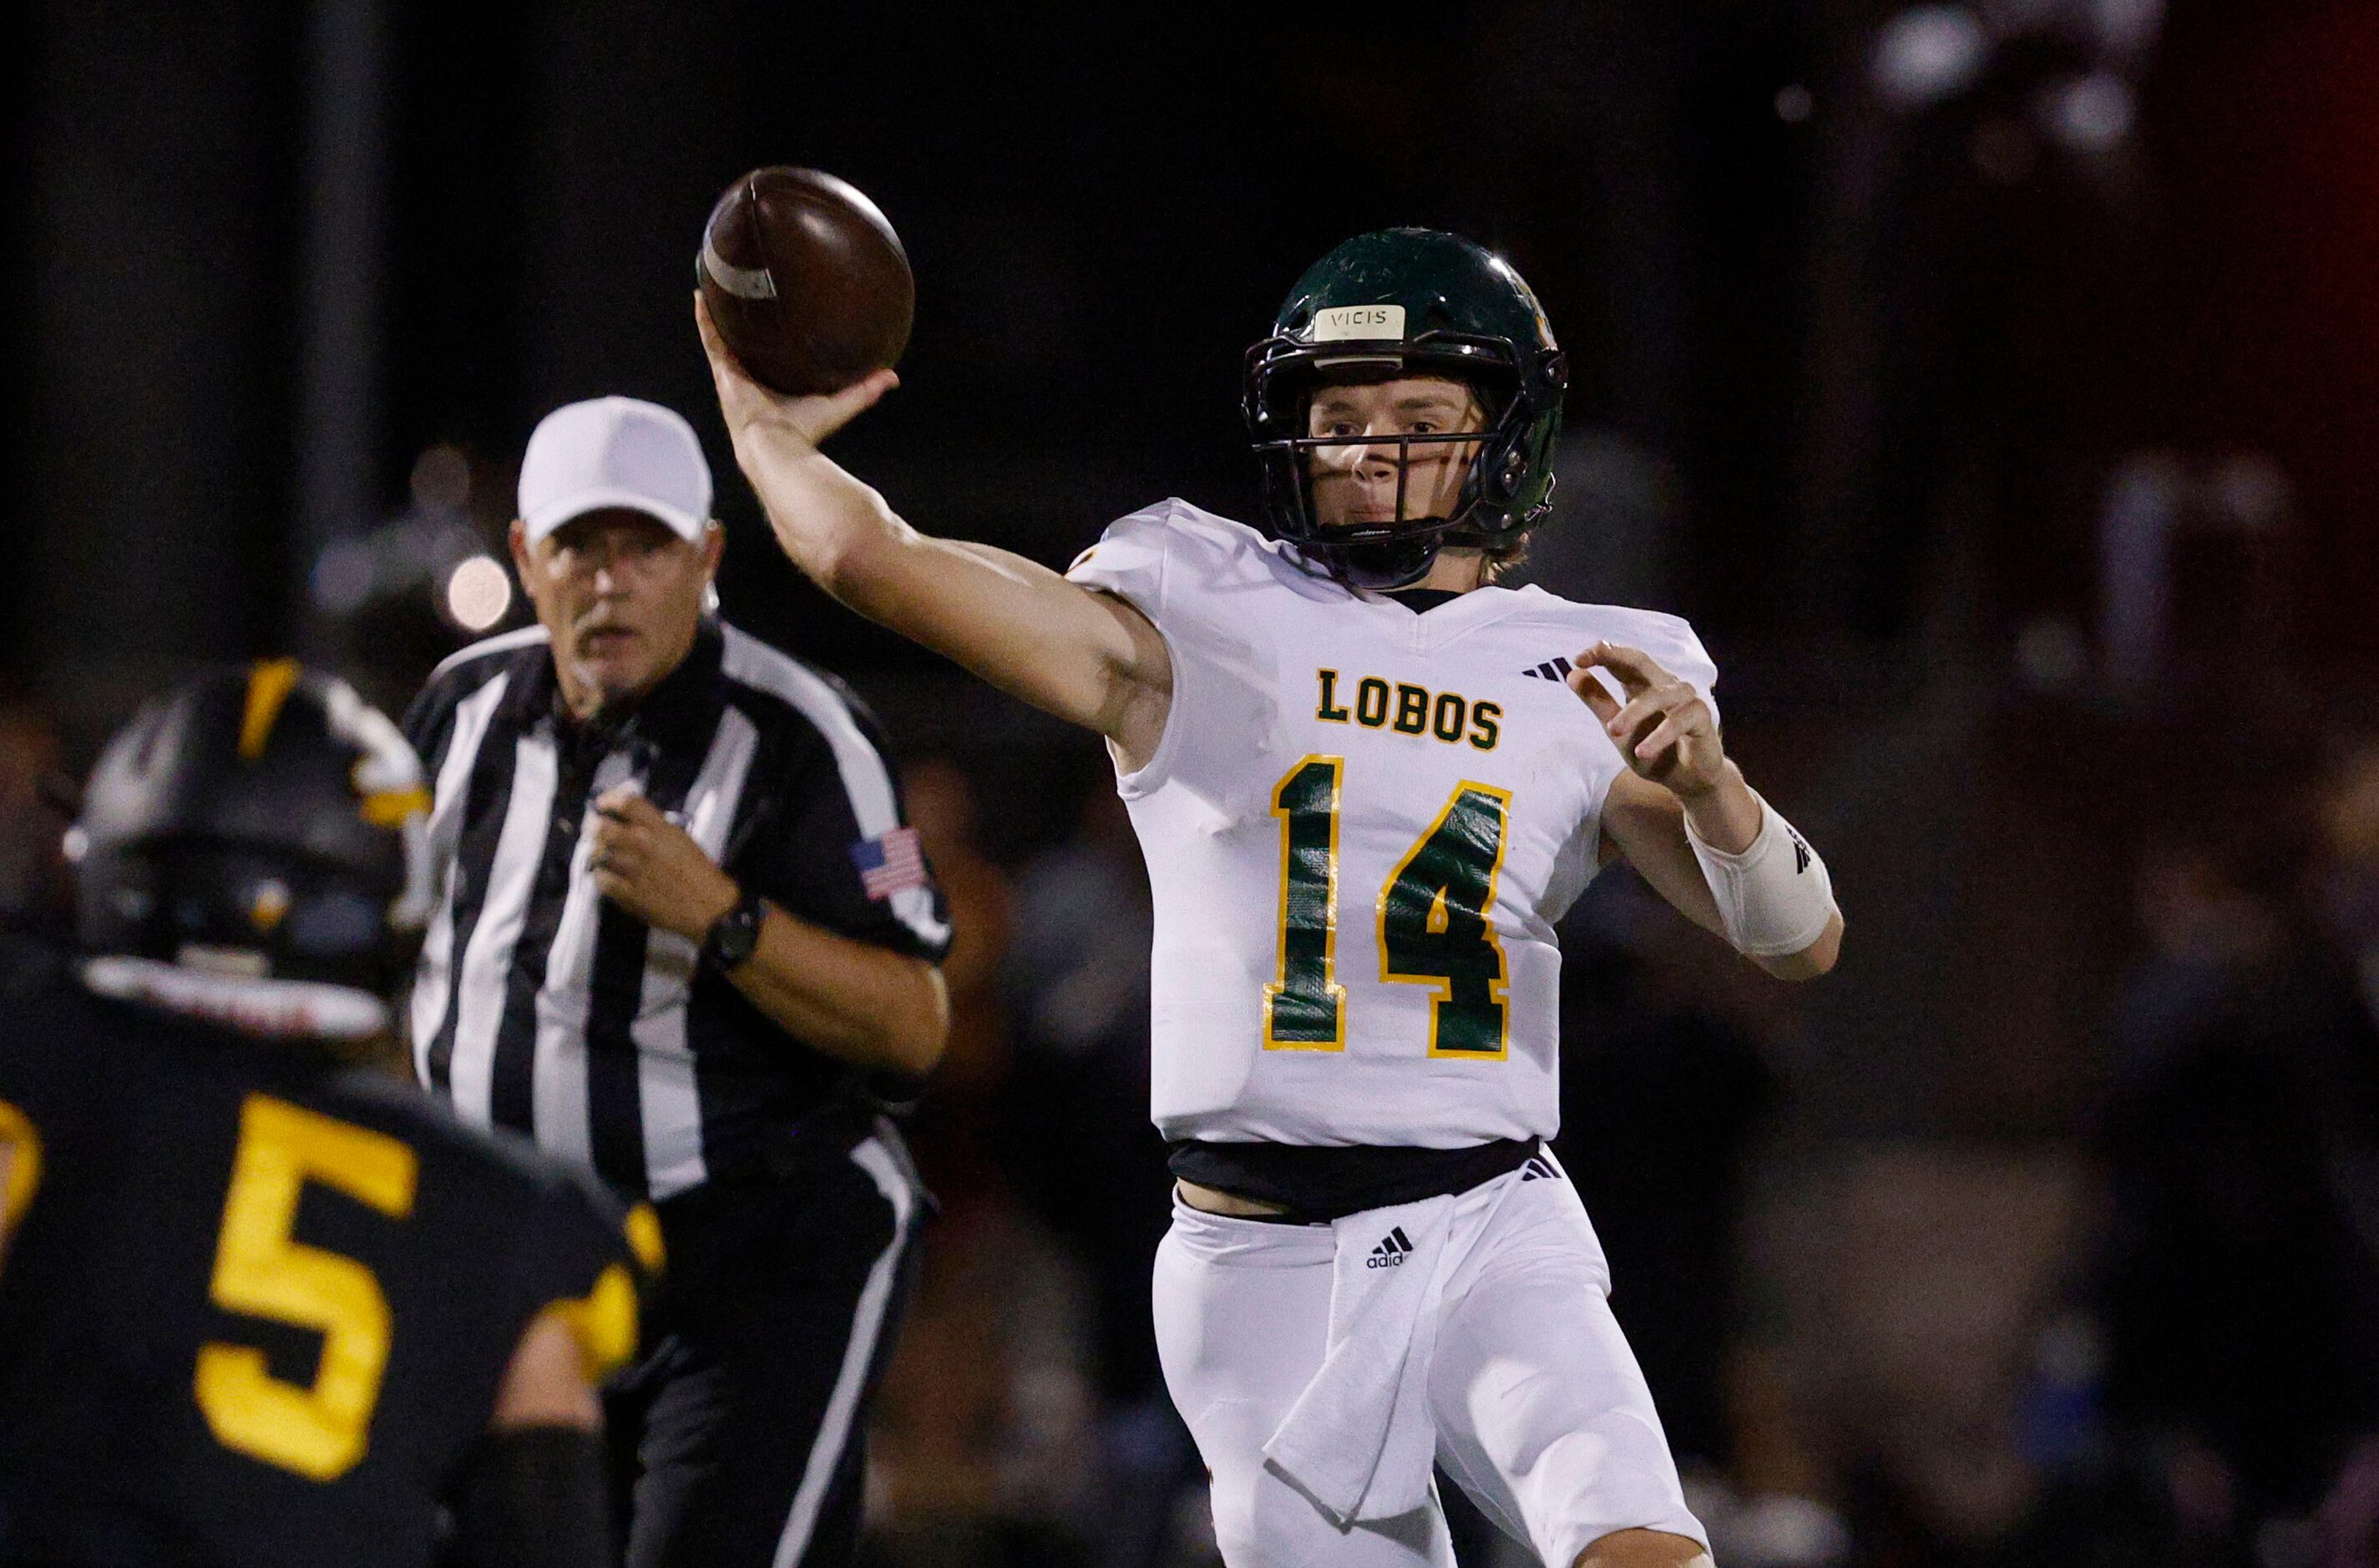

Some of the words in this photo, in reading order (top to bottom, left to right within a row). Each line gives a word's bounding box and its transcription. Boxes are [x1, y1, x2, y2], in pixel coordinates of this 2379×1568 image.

[1331, 311, 1387, 326] VICIS
[1316, 668, 1504, 752] LOBOS
[1263, 753, 1512, 1061] 14
[194, 1092, 418, 1483] 5
[1366, 1252, 1404, 1269] adid
